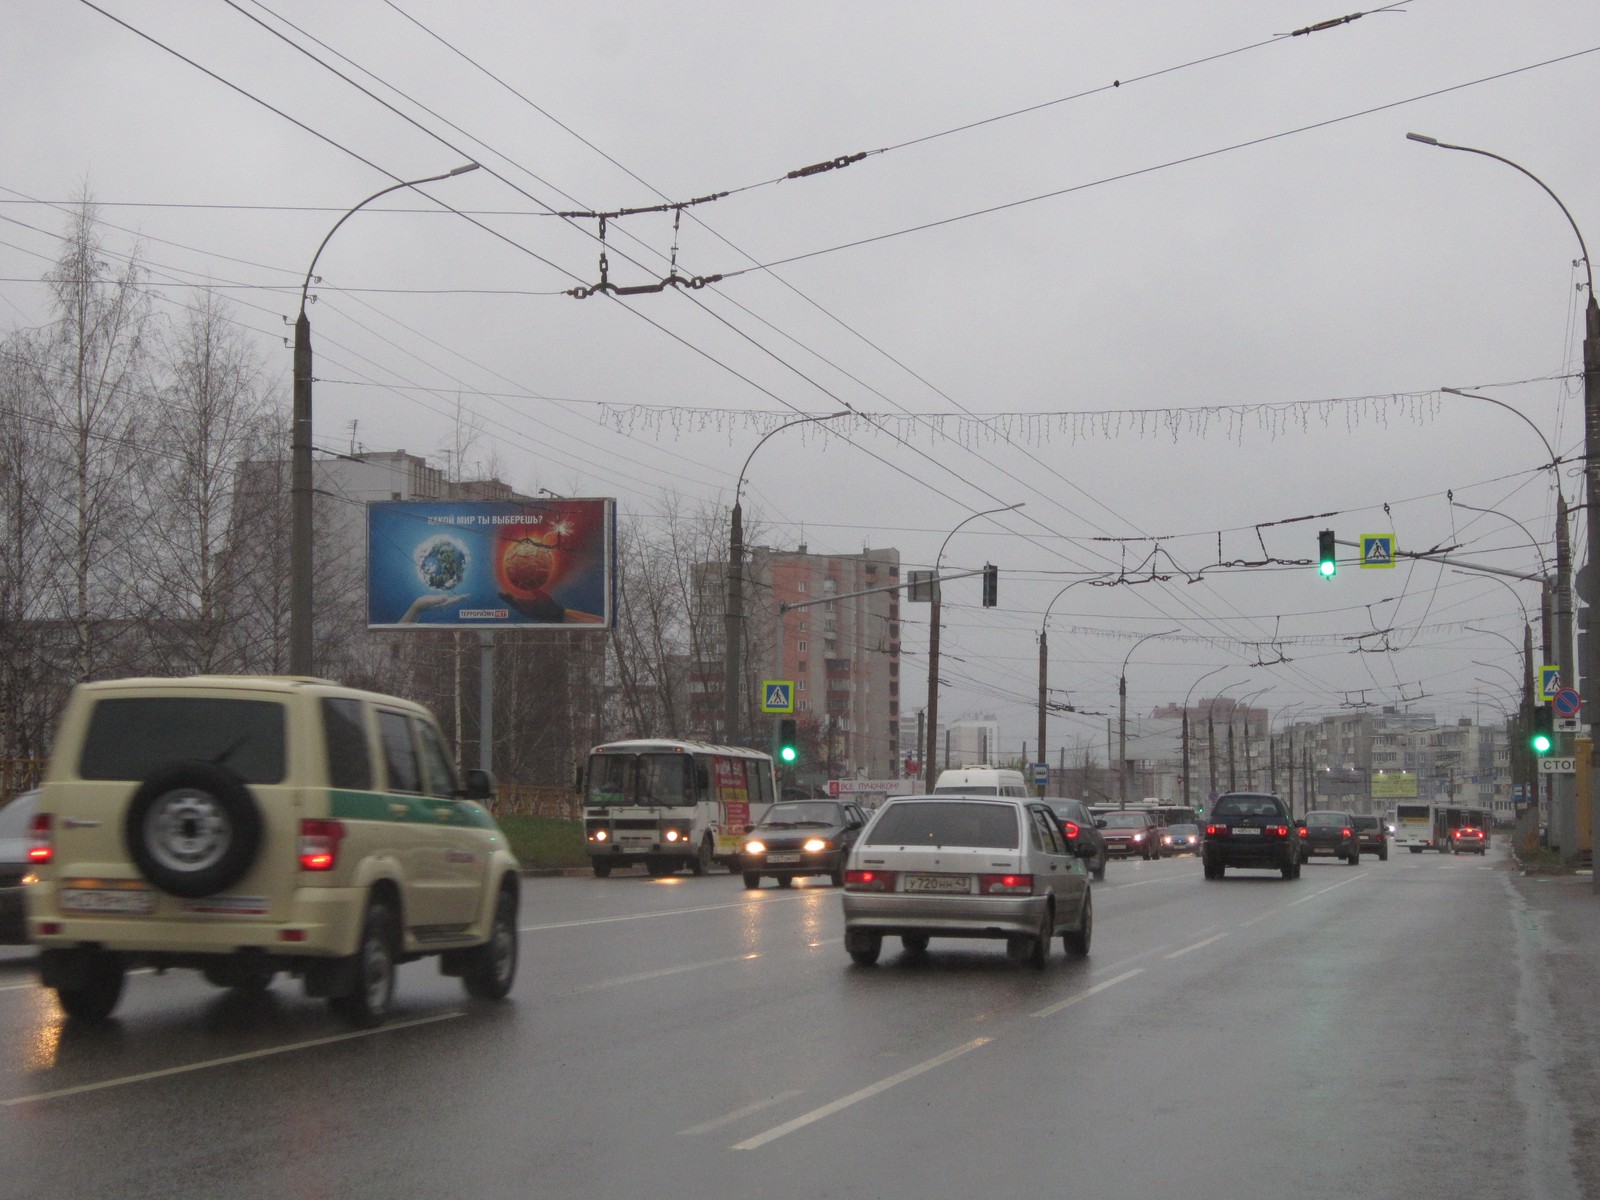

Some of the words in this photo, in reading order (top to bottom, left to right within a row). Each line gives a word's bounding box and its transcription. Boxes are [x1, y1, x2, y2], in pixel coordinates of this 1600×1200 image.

[428, 515, 454, 525] КАКОЙ
[457, 516, 475, 525] МИР
[478, 516, 490, 525] ТЫ
[492, 515, 543, 525] ВЫБЕРЕШЬ?
